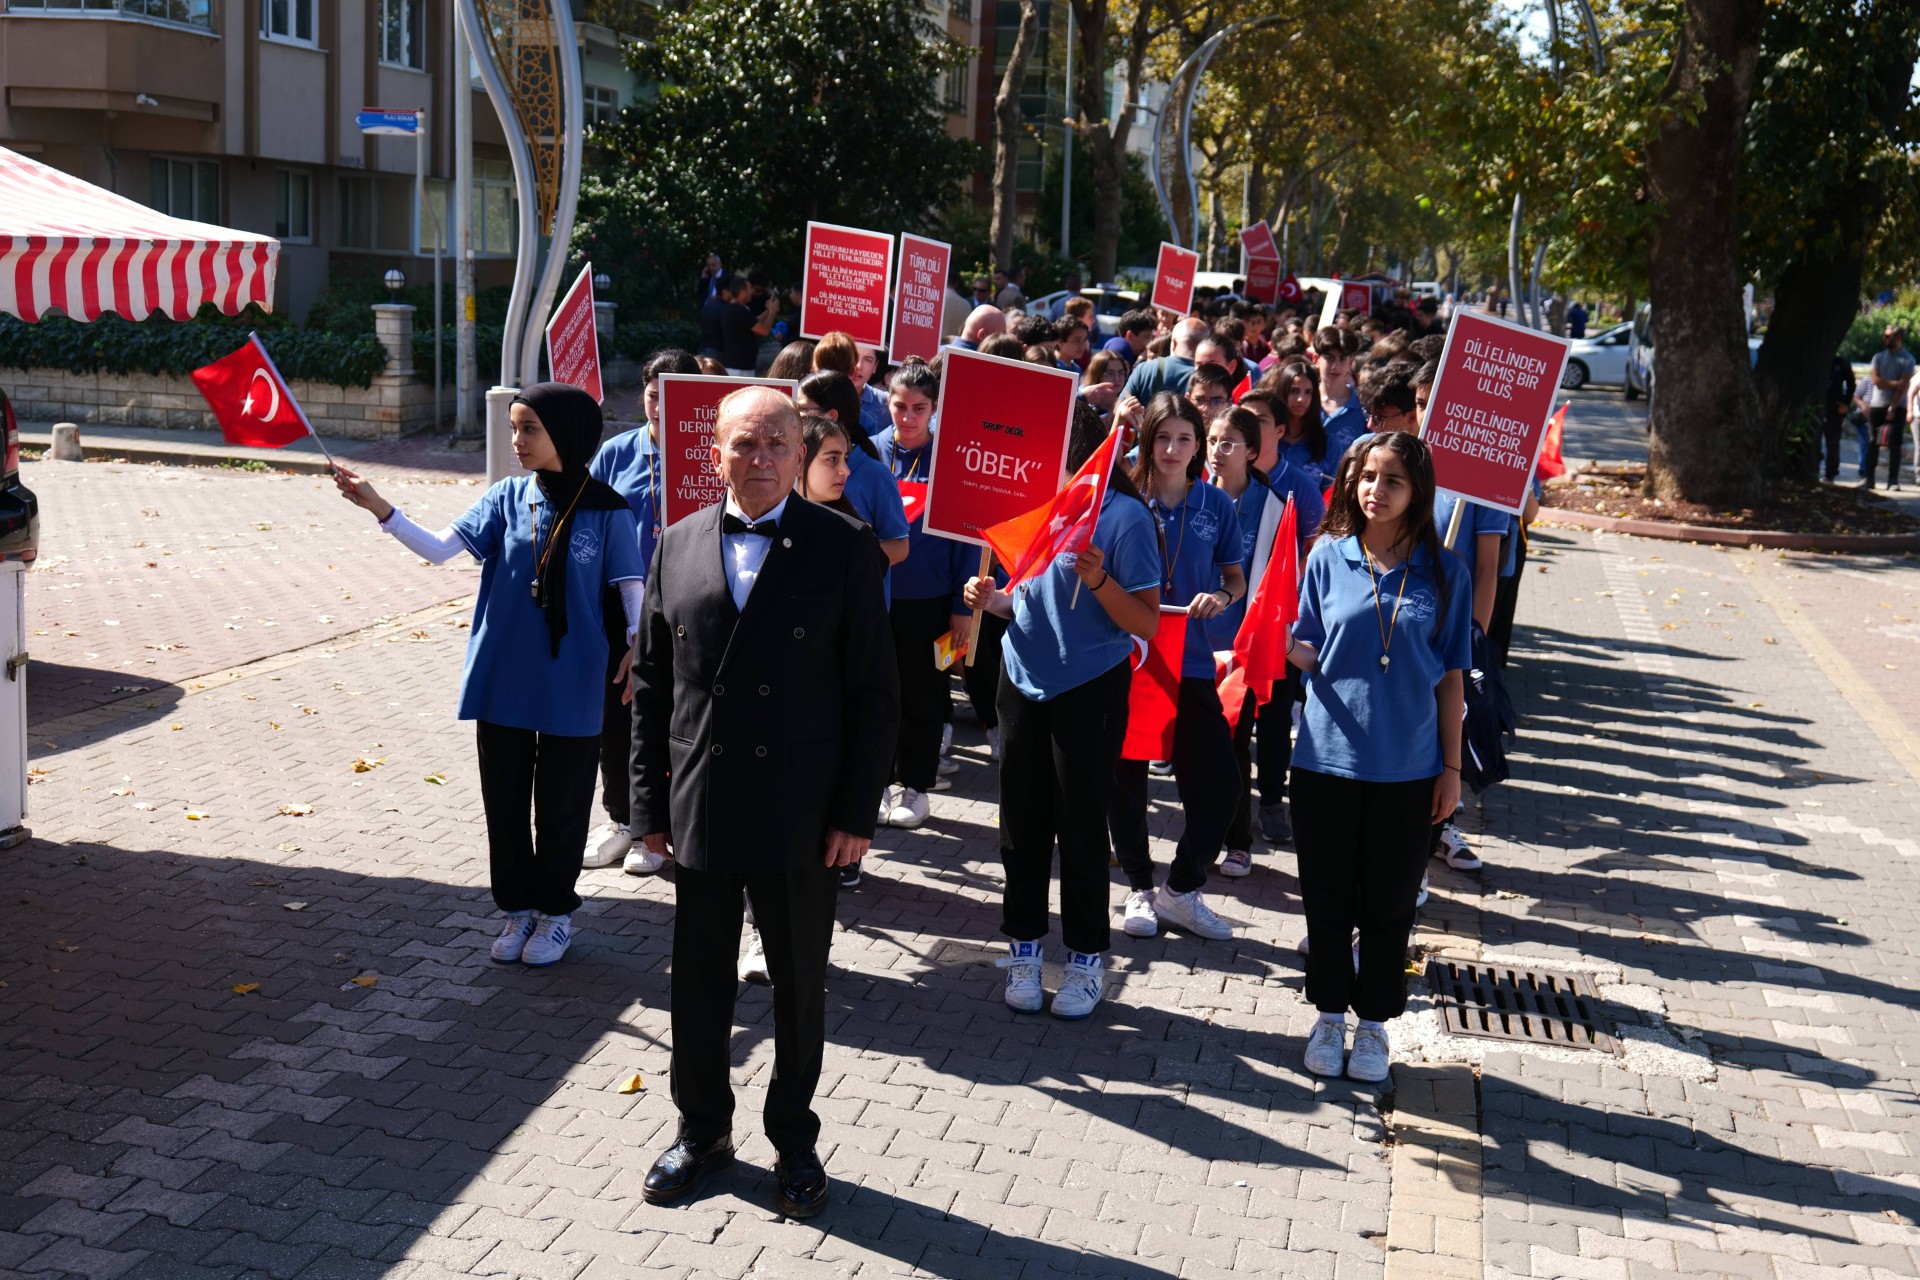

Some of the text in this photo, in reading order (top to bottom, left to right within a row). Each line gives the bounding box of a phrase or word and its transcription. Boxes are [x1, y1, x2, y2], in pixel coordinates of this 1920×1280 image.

[849, 249, 884, 260] KAYBEDEN
[910, 252, 940, 273] TÜRK DİLİ
[842, 274, 874, 286] FELAKETE
[849, 268, 883, 281] KAYBEDEN
[915, 268, 931, 286] TÜRK
[903, 280, 940, 301] MİLLETİNİN
[837, 295, 872, 306] KAYBEDEN
[844, 302, 856, 310] YOK
[858, 304, 880, 316] OLMUŞ
[1464, 337, 1547, 376] DİLİ ELİNDEN
[1462, 356, 1539, 390] ALINMIŞ BİR
[1477, 377, 1513, 401] ULUS,
[694, 405, 718, 420] TÜR
[1445, 401, 1529, 438] USU ELİNDEN
[680, 419, 716, 433] DERİN
[701, 436, 716, 447] DA
[1444, 419, 1520, 450] ALINMIŞ BİR
[686, 445, 712, 460] GÖZ
[1426, 429, 1528, 471] ULUS DEMEKTİR.
[700, 462, 715, 474] SE
[955, 440, 1042, 483] "ÖBEK"
[676, 485, 723, 500] YÜKSEK
[699, 499, 714, 510] GÖ
